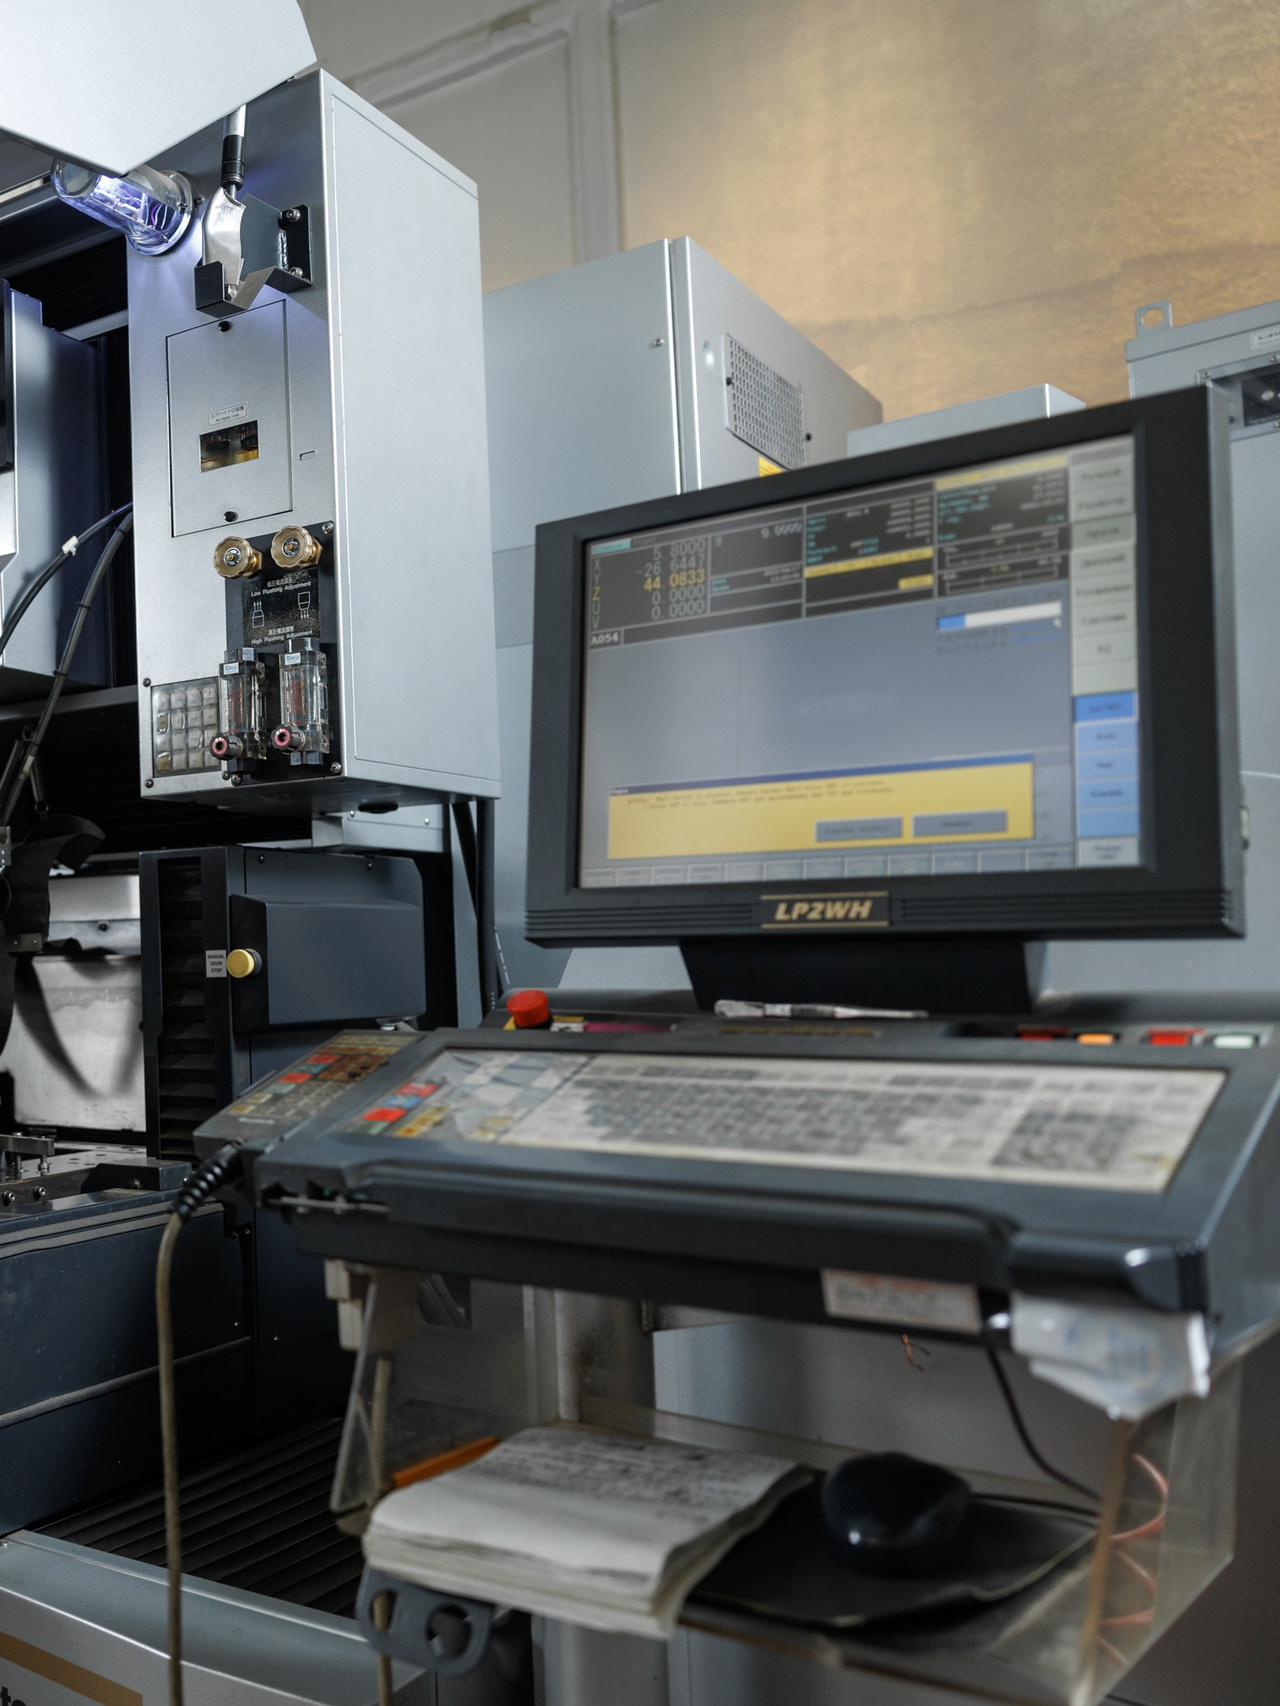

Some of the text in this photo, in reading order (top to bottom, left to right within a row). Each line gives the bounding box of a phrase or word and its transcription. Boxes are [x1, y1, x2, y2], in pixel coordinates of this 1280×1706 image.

[262, 586, 283, 595] Flushing
[285, 581, 311, 590] Adjustment
[286, 630, 313, 639] Adjustment
[774, 900, 873, 921] LP2WH
